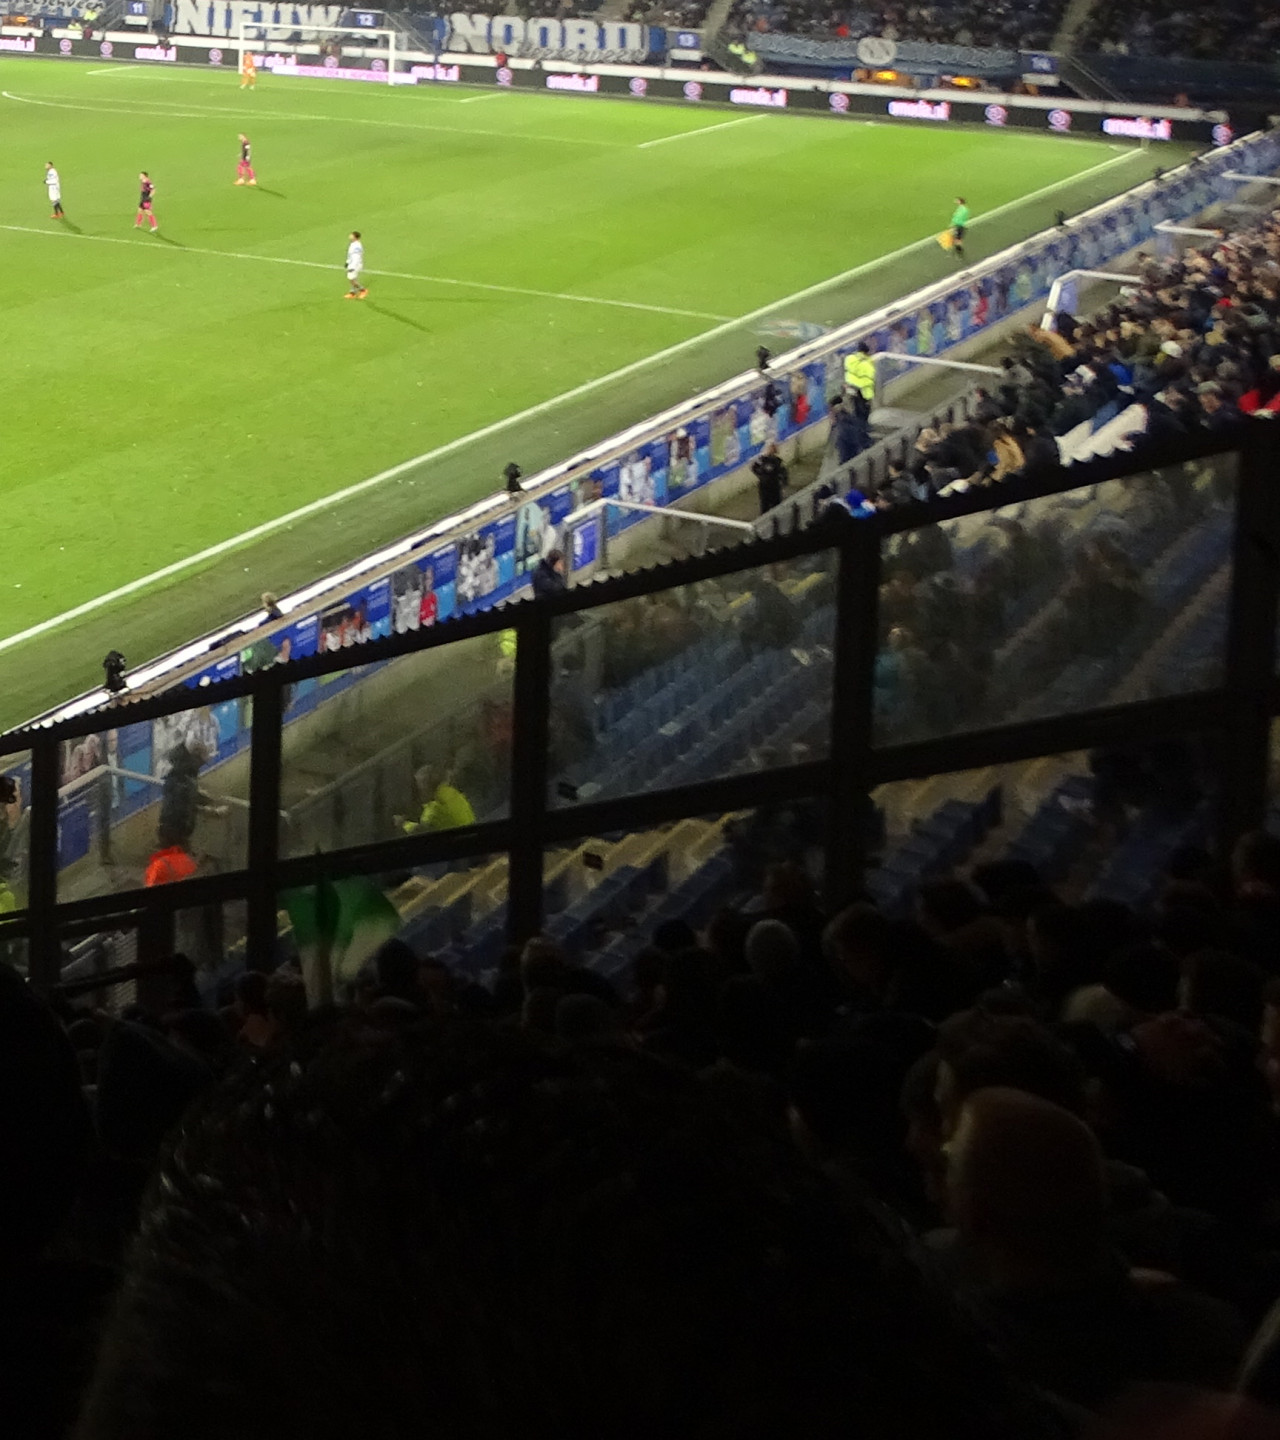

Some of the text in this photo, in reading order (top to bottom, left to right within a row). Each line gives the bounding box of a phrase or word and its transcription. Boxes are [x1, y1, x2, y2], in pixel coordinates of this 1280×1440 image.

[132, 2, 144, 14] 11
[358, 14, 374, 26] 12
[448, 12, 648, 57] NOORD
